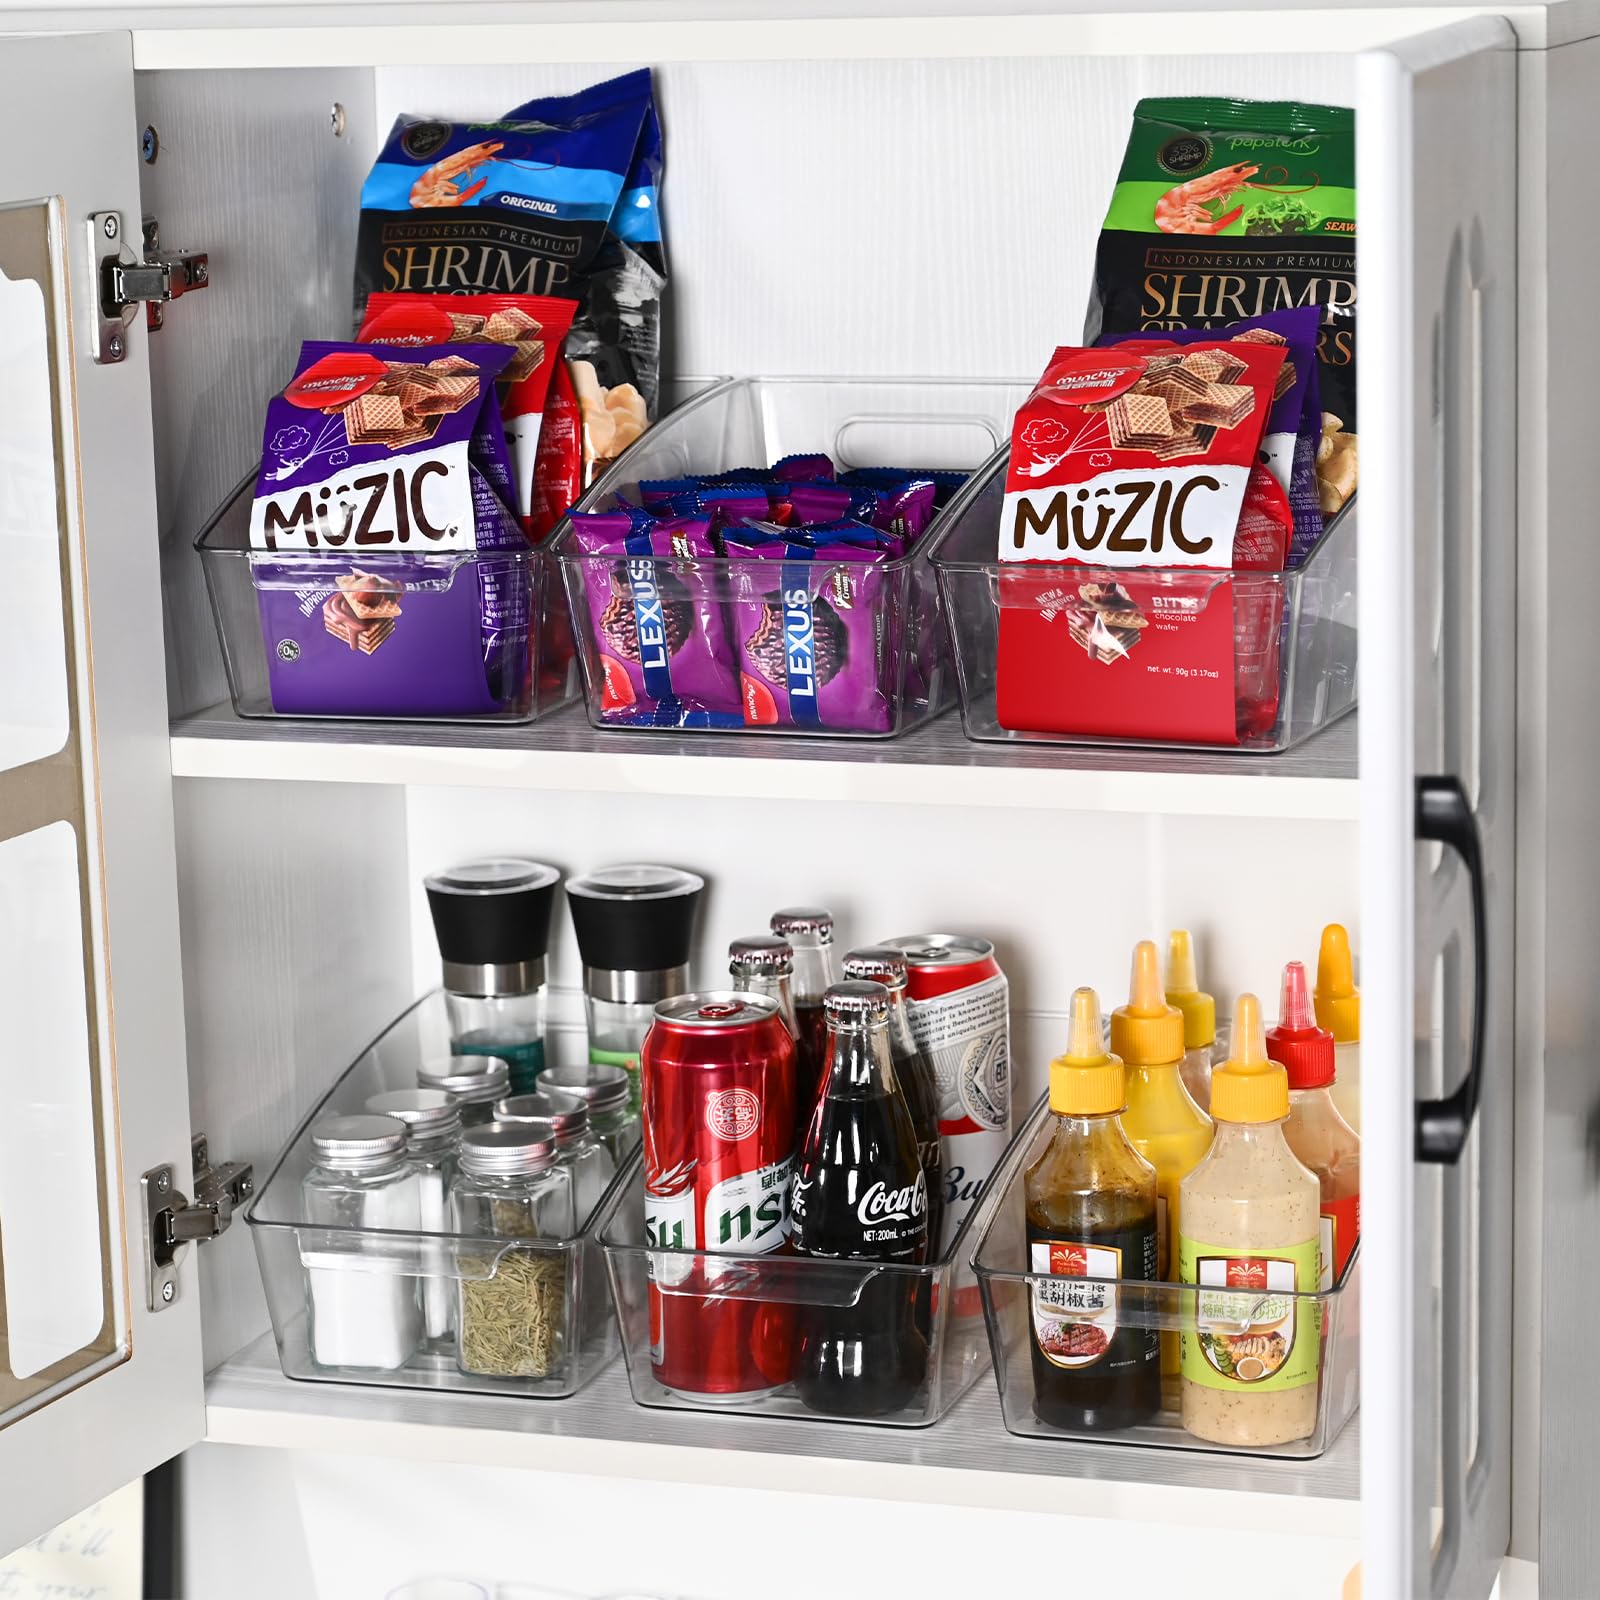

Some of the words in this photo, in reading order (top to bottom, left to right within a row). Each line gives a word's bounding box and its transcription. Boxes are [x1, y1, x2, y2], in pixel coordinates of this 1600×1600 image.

[501, 195, 557, 214] ORIGINAL
[1324, 221, 1356, 231] SEAW
[388, 226, 489, 239] INDONESIAN
[499, 229, 576, 253] PREMIUM
[1154, 254, 1265, 267] INDONESIAN
[1277, 255, 1356, 268] PREMIUM
[383, 246, 570, 297] SHRIMP
[1140, 273, 1356, 326] SHRIMP
[405, 578, 448, 592] BITES
[1152, 597, 1199, 609] BITES
[630, 560, 667, 669] LEXUS
[1154, 612, 1198, 622] chocolate
[1155, 623, 1179, 632] wafer
[784, 589, 814, 697] LEXUS
[1175, 668, 1189, 677] 90g
